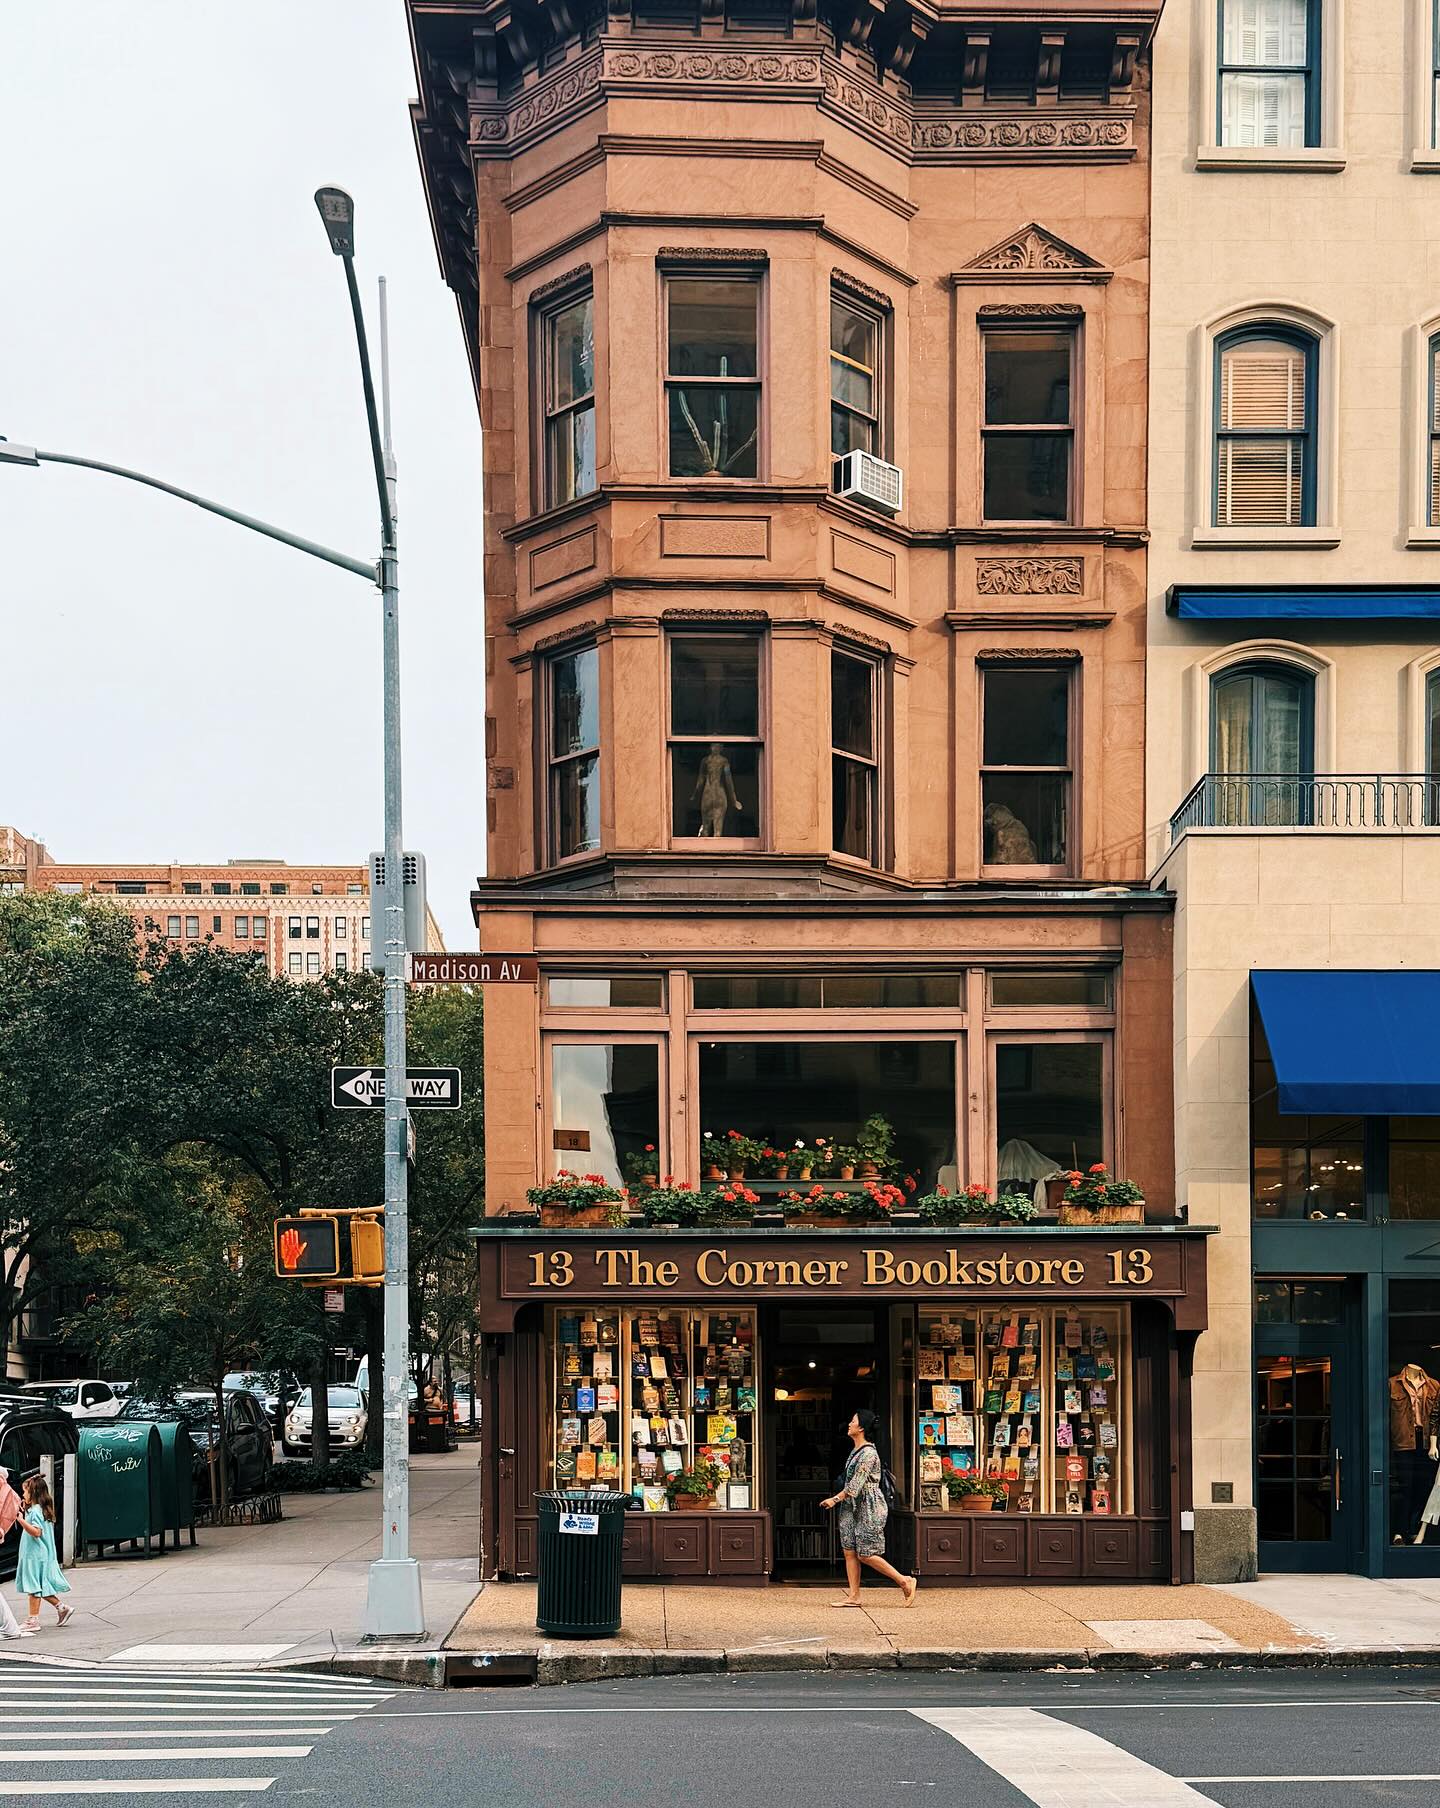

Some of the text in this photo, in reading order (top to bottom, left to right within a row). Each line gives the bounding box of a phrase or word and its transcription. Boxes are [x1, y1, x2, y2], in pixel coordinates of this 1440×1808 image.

[414, 959, 521, 980] Madison Av
[354, 1080, 446, 1096] ONE WAY
[529, 1249, 1154, 1287] 13 The Corner Bookstore 13
